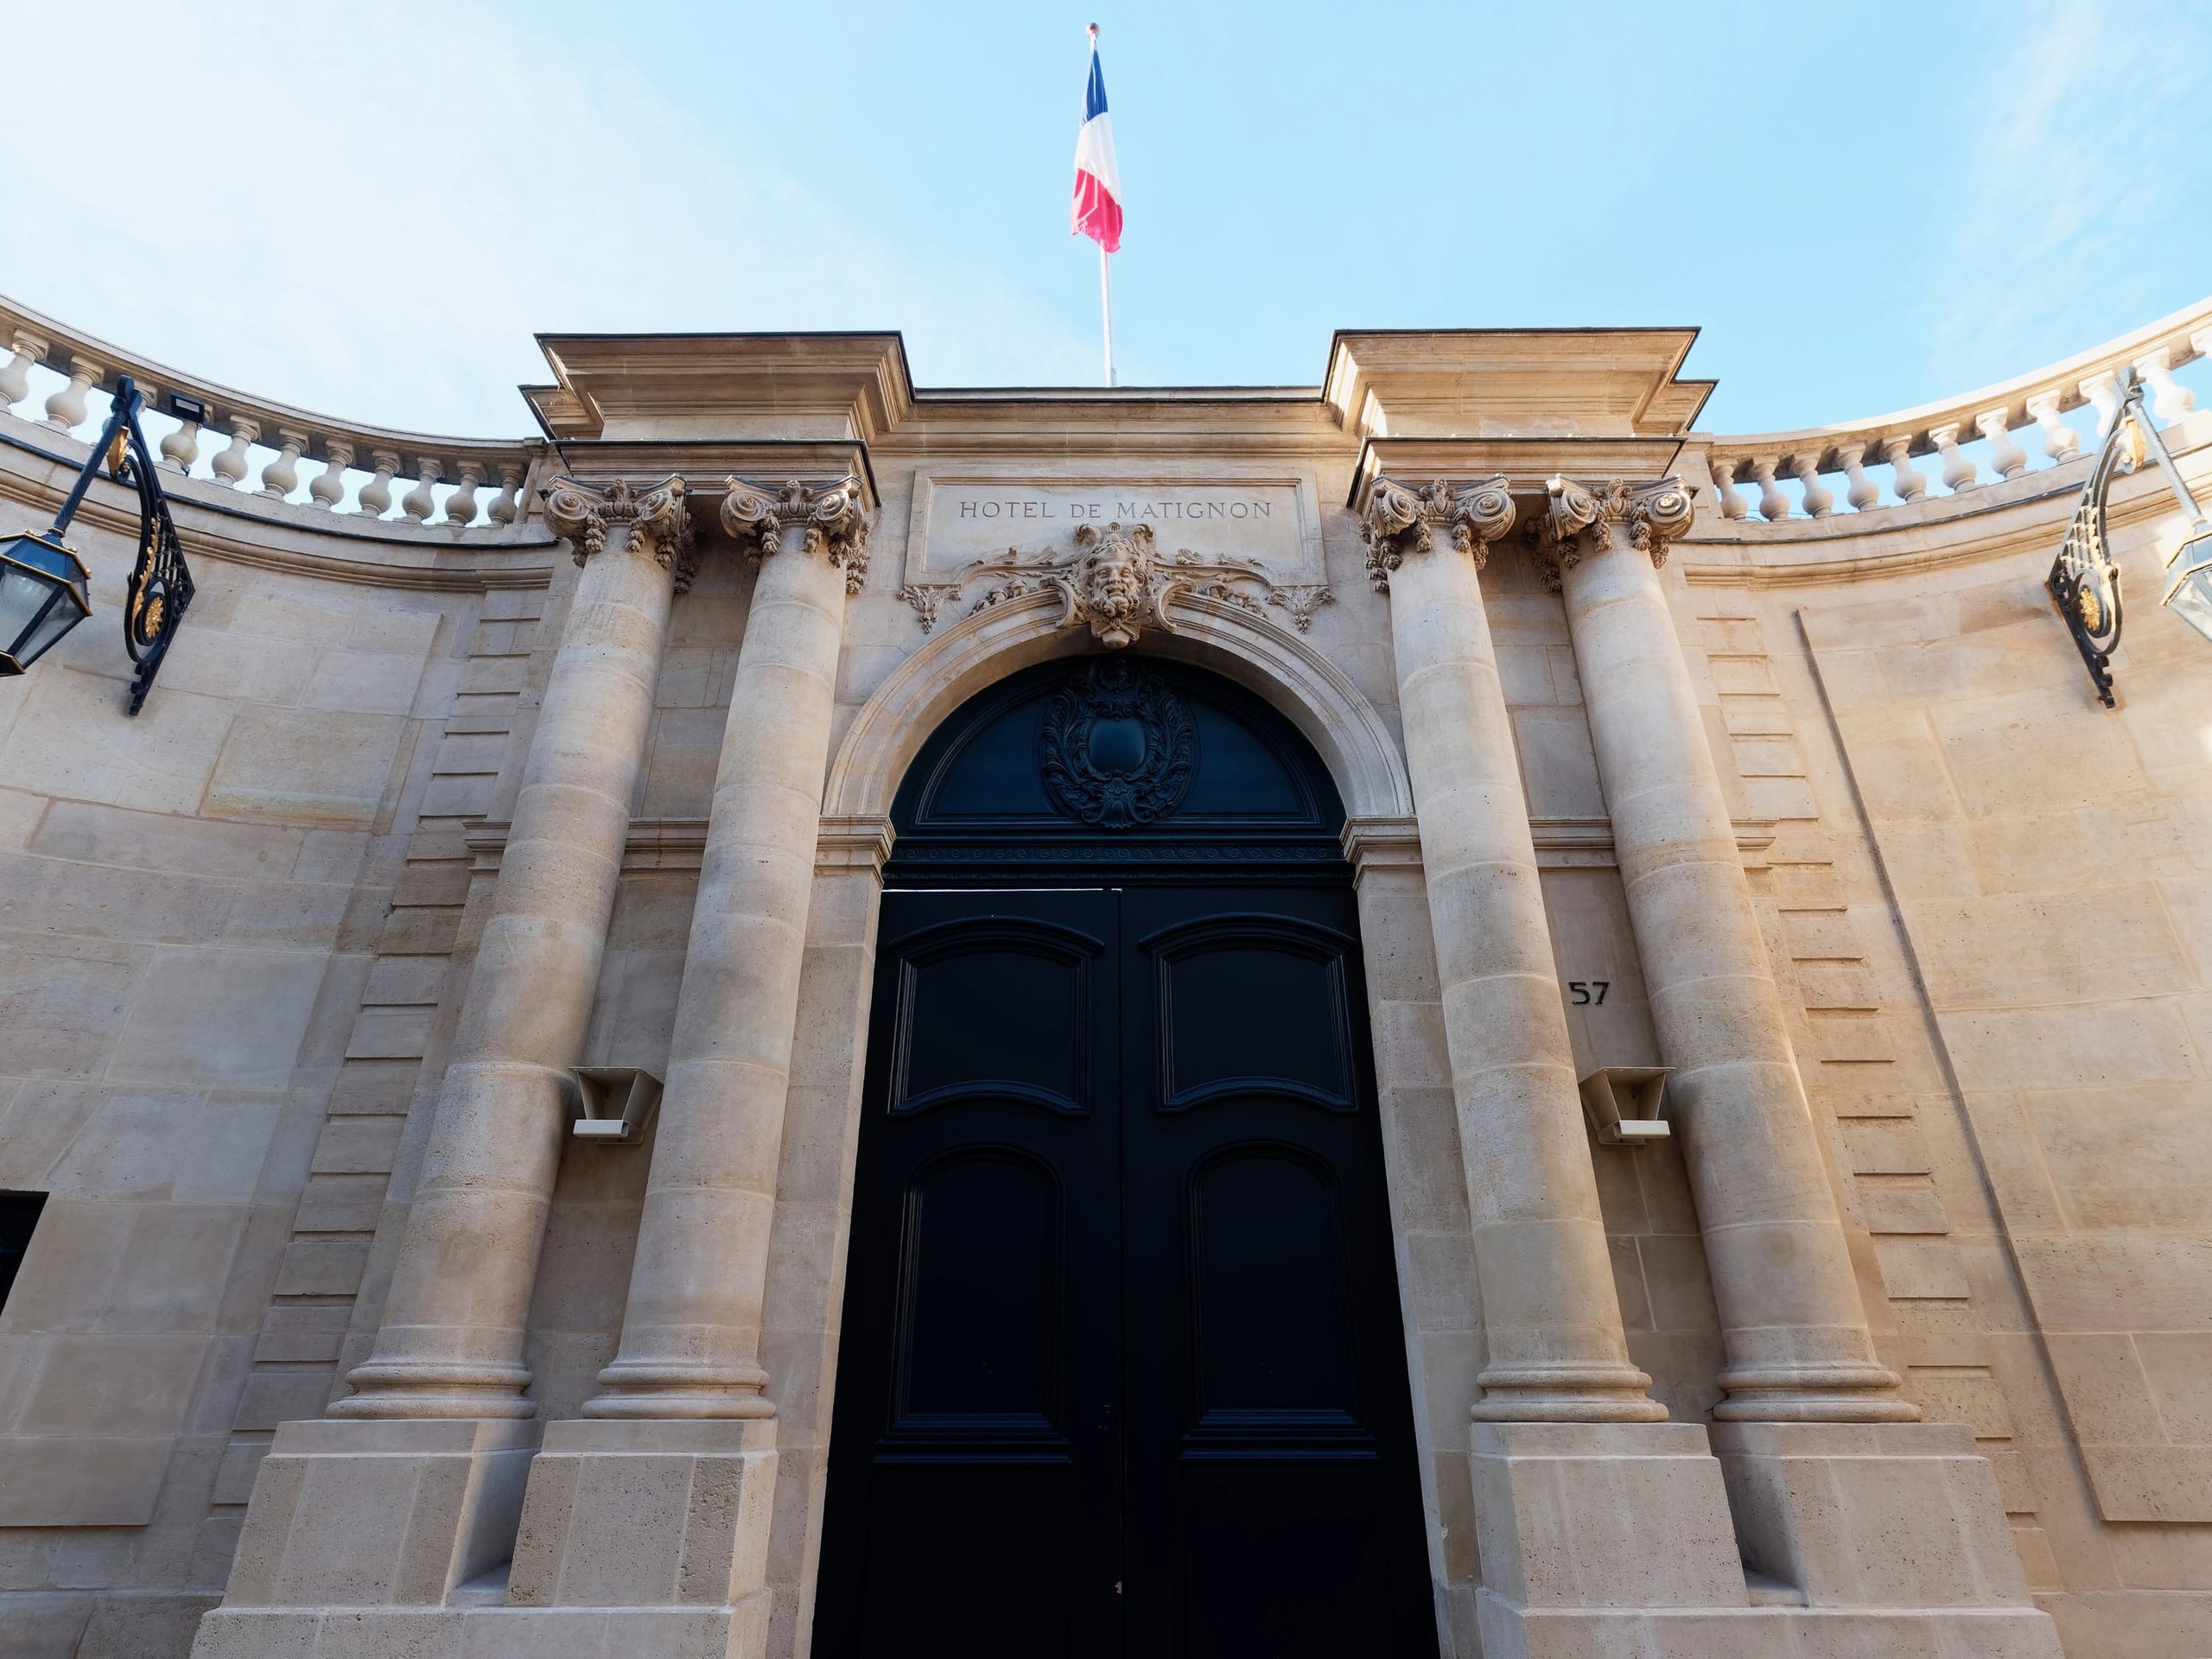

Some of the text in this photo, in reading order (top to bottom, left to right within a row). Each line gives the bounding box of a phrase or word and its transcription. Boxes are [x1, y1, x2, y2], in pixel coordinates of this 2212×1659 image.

[960, 501, 1272, 518] HOTEL DE MATIGNON
[1568, 982, 1611, 1005] 57
